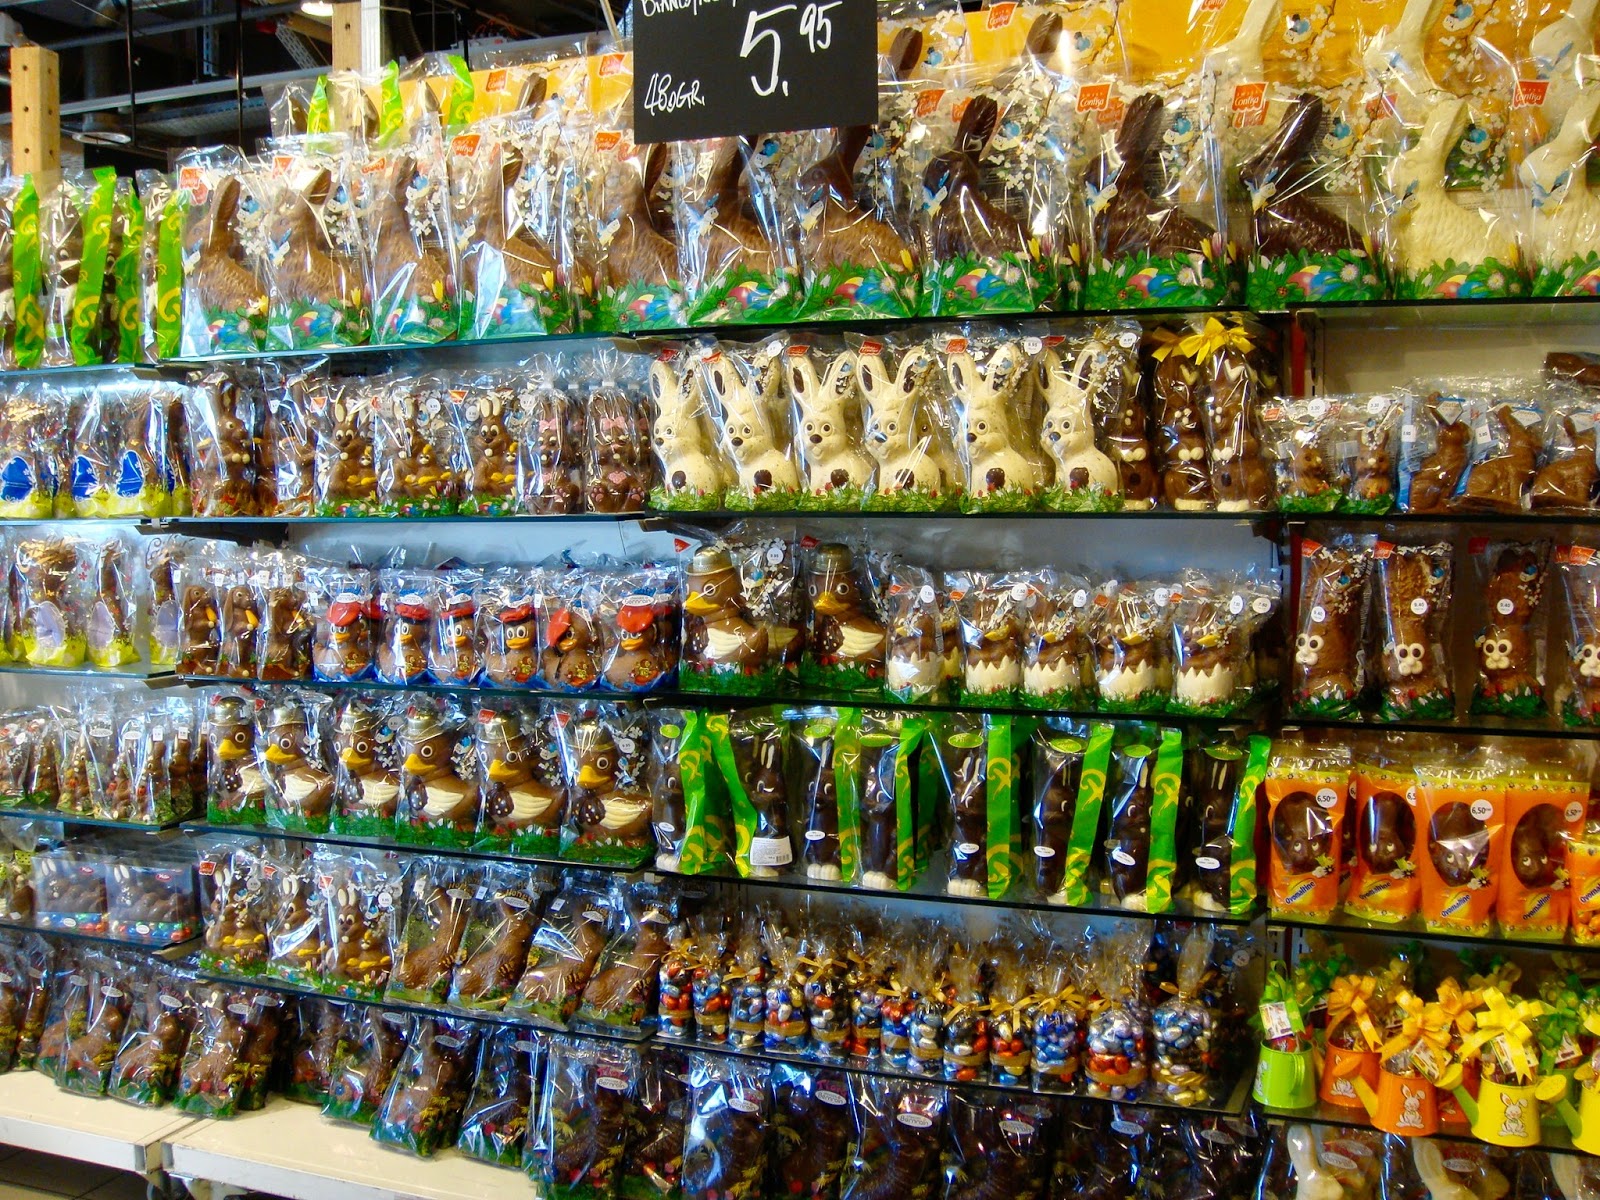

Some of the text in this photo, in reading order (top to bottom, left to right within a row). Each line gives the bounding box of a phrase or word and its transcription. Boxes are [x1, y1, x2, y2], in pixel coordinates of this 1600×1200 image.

[1317, 795, 1330, 803] 6,50
[1471, 806, 1486, 815] 6,50
[506, 888, 533, 905] Honey
[1285, 879, 1316, 905] Ovomaltine
[1441, 893, 1471, 918] Ovomaltine
